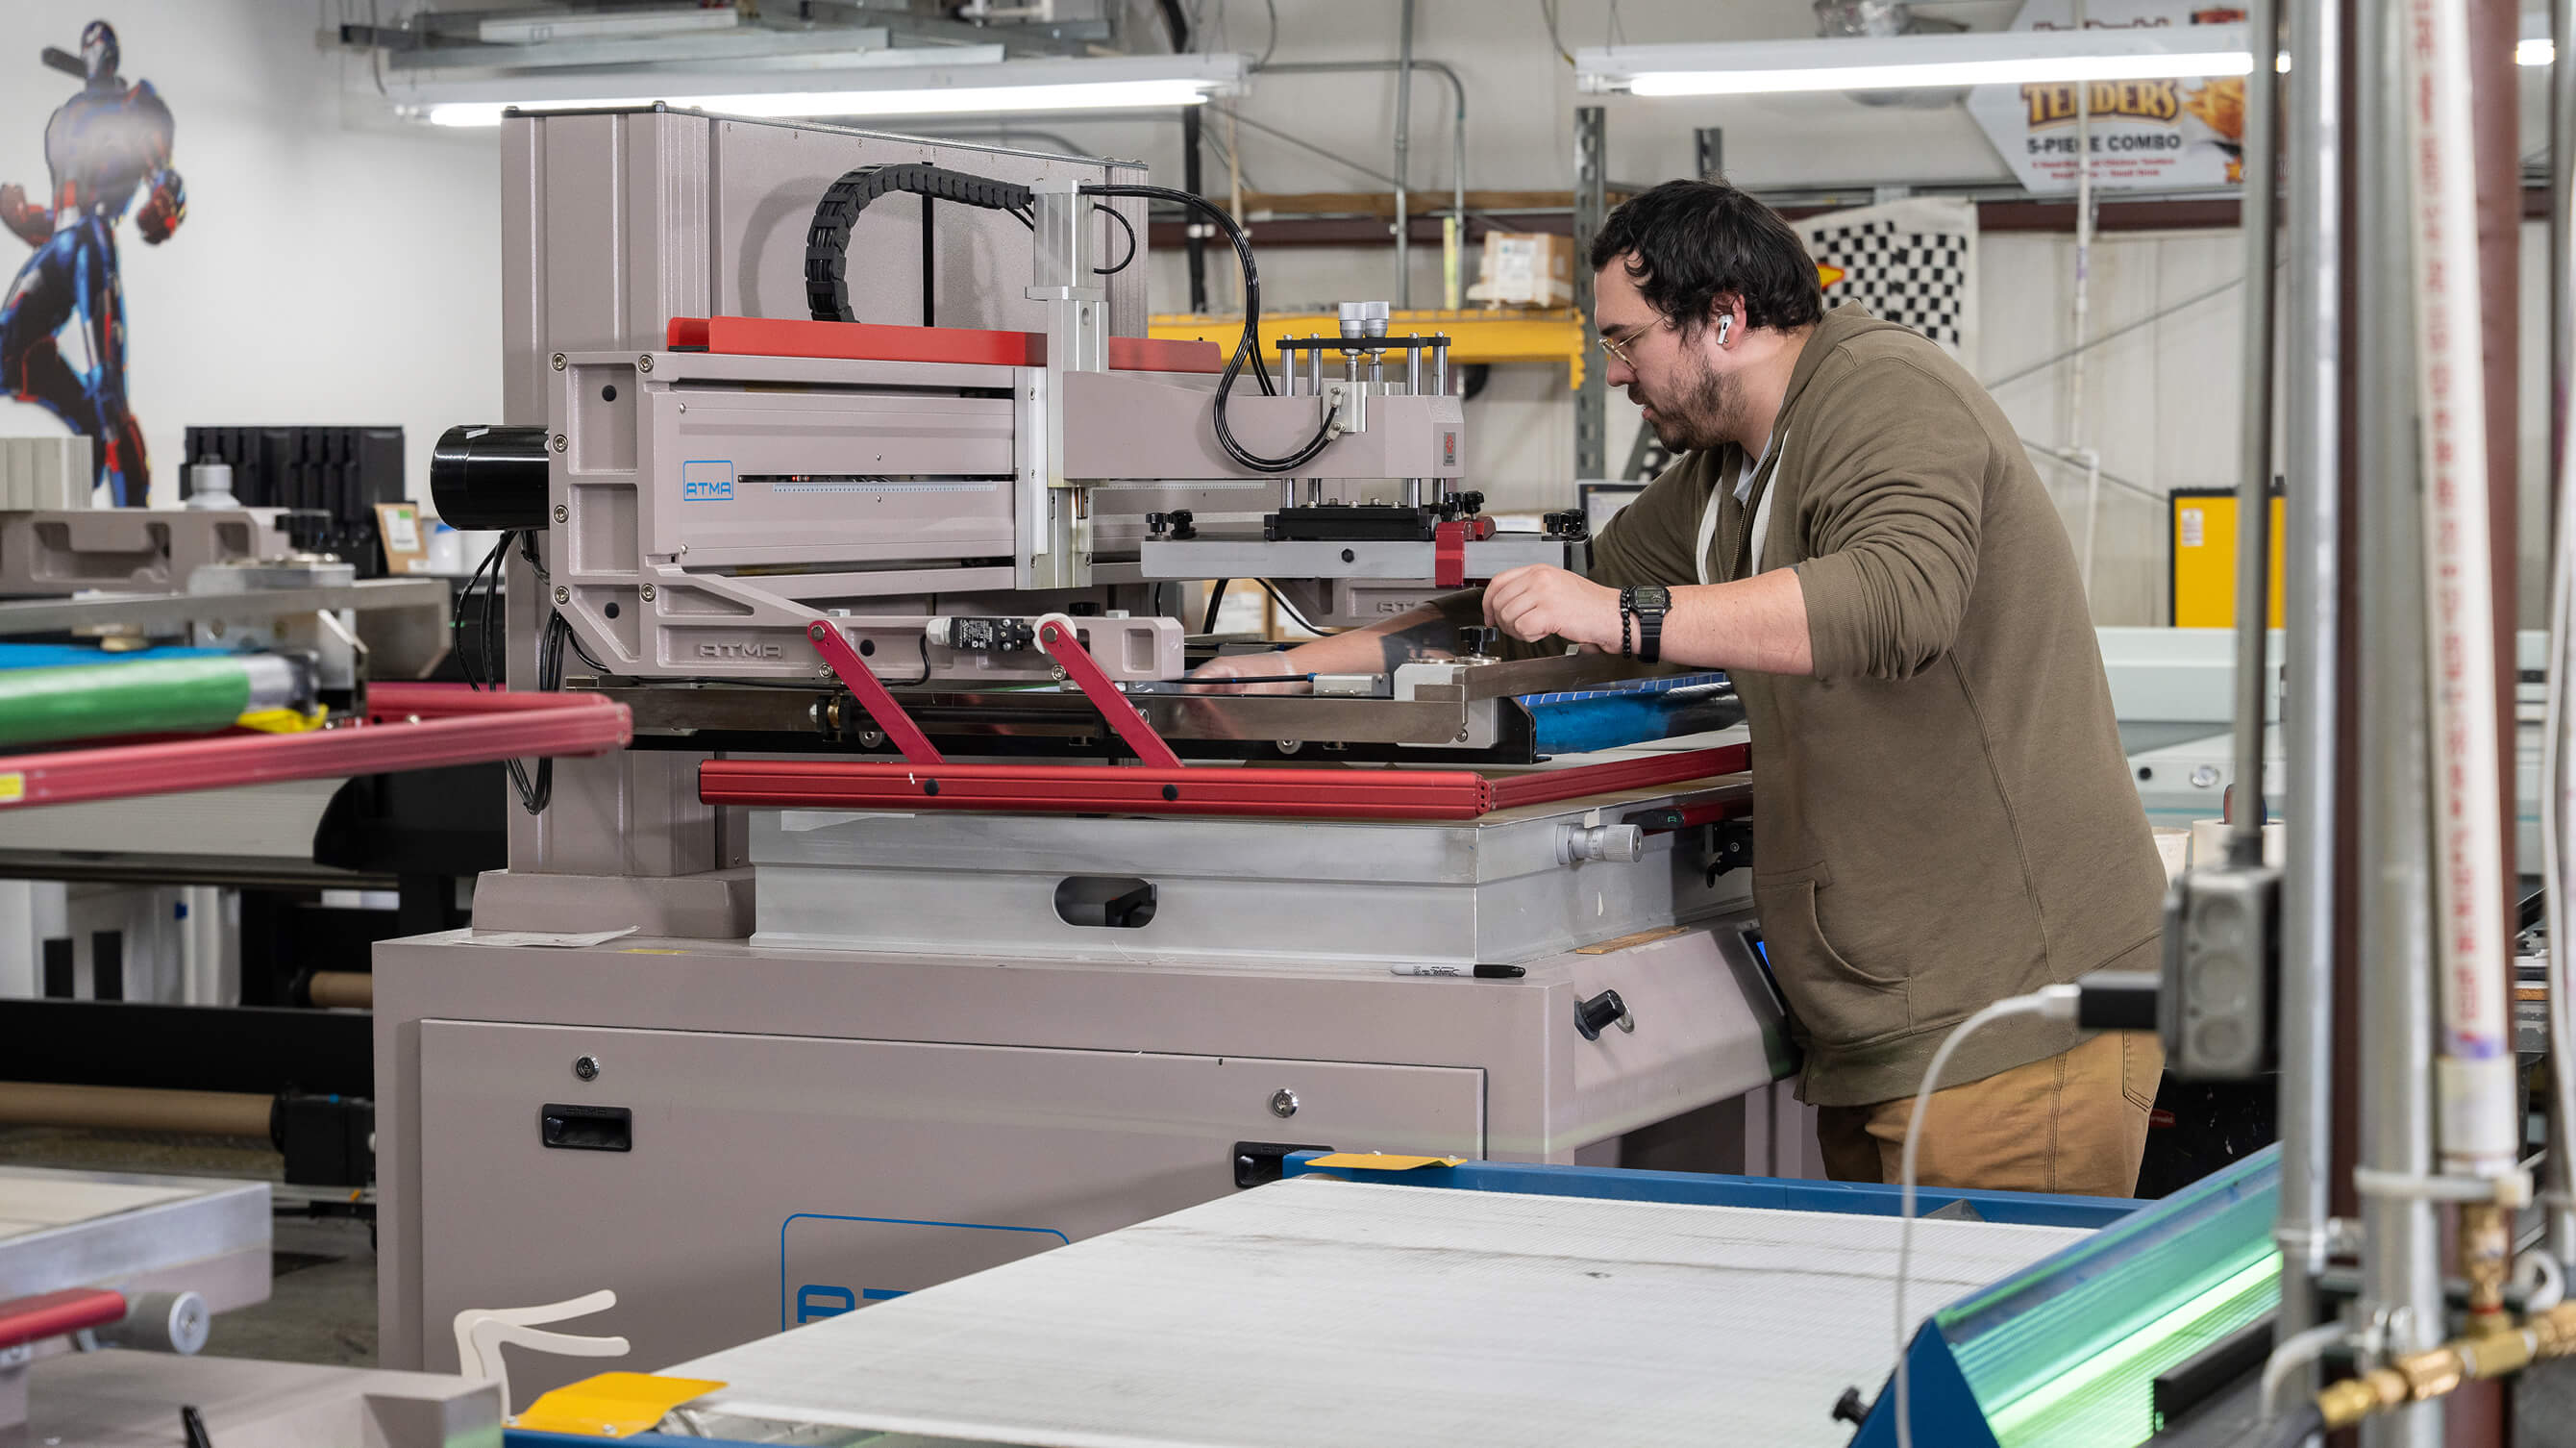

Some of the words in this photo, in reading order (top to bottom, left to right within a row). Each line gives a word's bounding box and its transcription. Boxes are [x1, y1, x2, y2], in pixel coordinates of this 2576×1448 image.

[2027, 137, 2100, 154] 5-PIEE
[2108, 135, 2181, 151] COMBO
[685, 482, 731, 495] ATMA
[698, 643, 784, 659] ATMA
